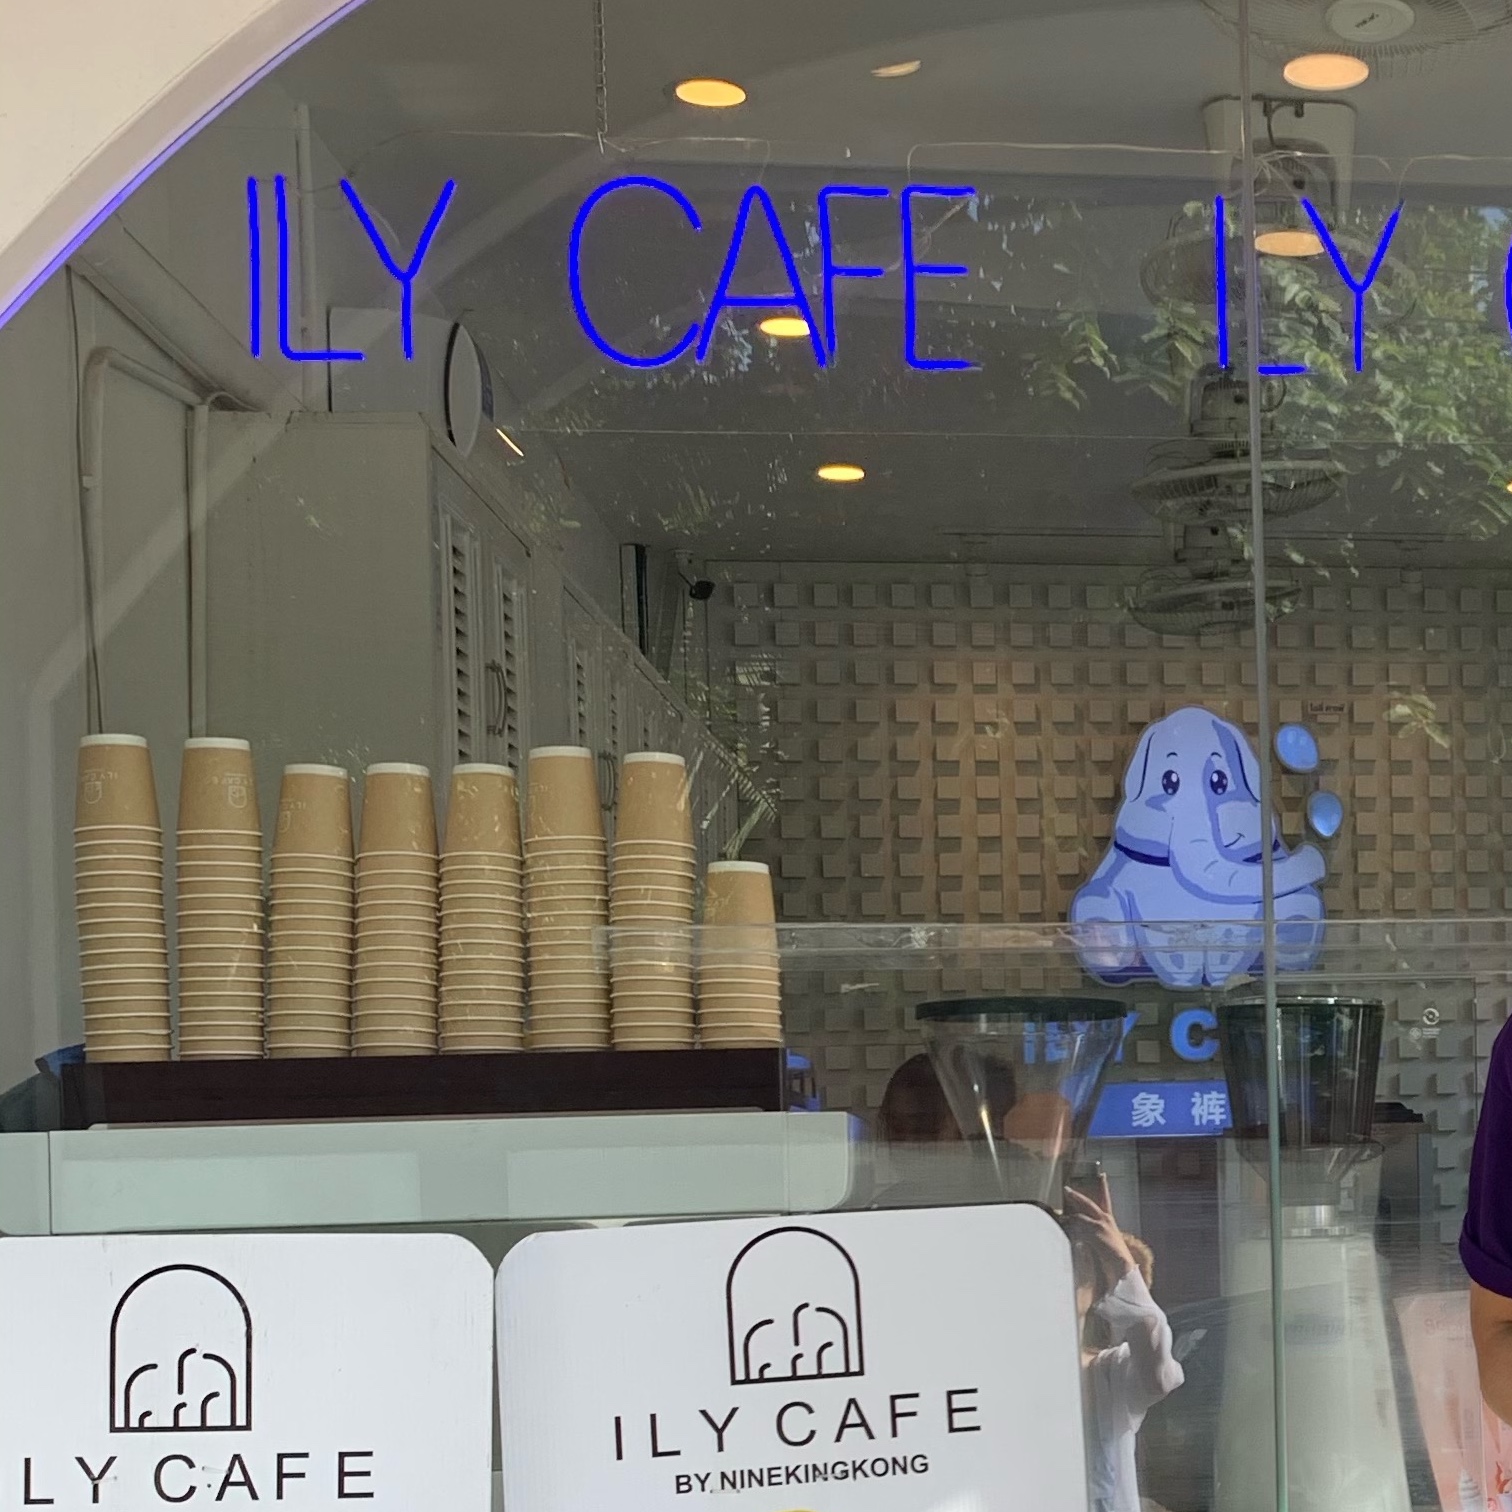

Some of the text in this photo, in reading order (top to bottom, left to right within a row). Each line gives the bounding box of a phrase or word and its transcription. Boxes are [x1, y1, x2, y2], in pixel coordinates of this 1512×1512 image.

[248, 174, 981, 370] ILY CAFE
[1214, 194, 1401, 374] IY
[613, 1387, 982, 1461] ILY CAFE
[23, 1450, 376, 1506] LY CAFE
[675, 1453, 930, 1495] BY NINEKINGKONG
